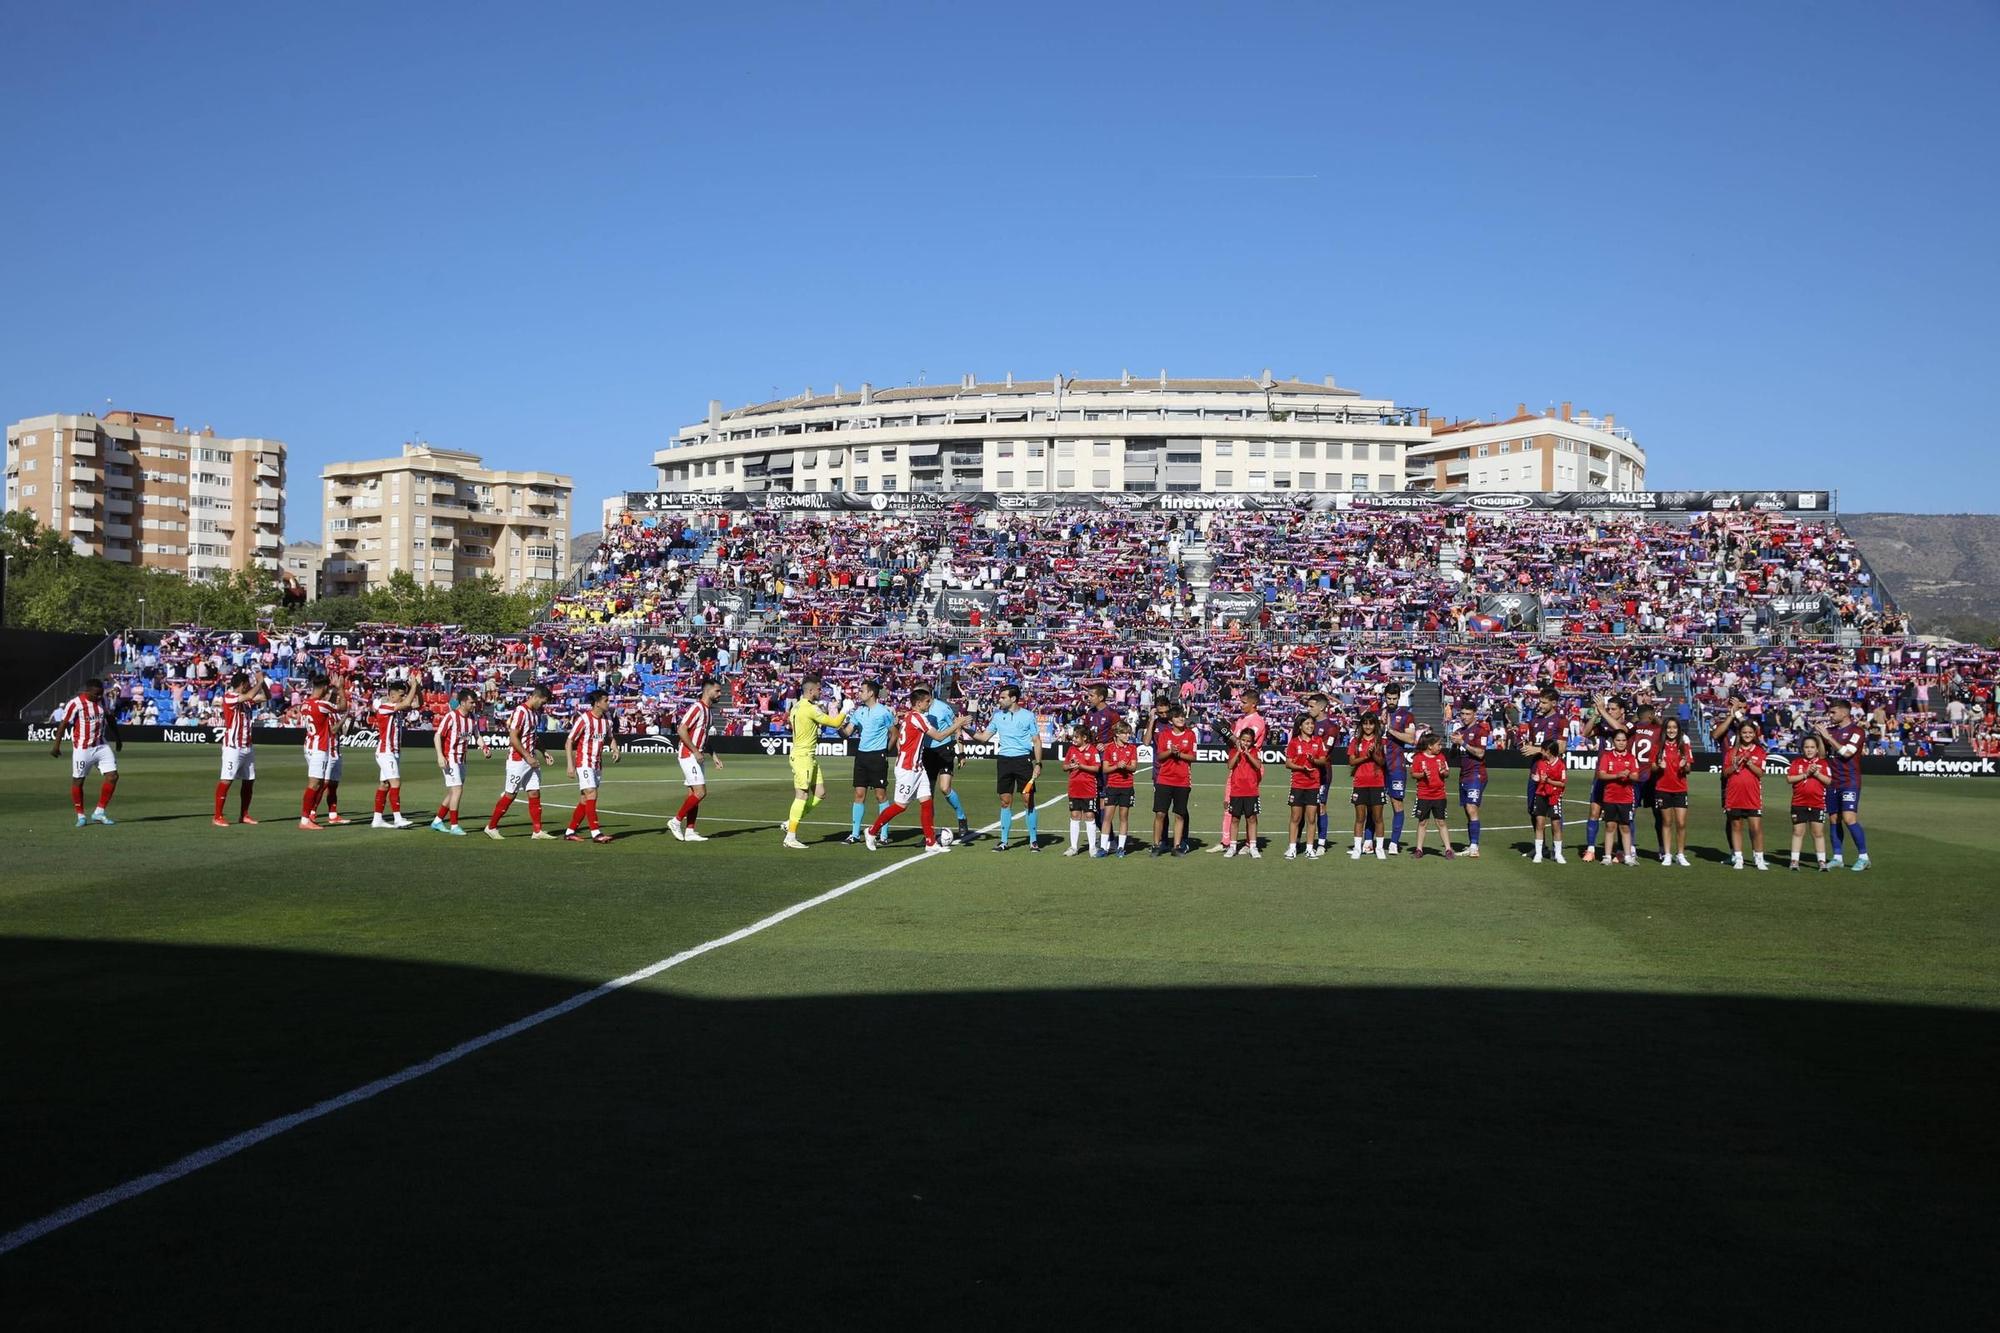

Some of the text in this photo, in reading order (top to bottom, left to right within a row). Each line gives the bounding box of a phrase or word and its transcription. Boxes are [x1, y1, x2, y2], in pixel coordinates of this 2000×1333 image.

[661, 494, 723, 505] INVERCUR
[888, 494, 944, 503] ALIPACK
[1160, 494, 1246, 509] finetwork
[1382, 498, 1411, 506] BOXES
[1609, 493, 1656, 503] PALLEX
[1792, 601, 1820, 609] IMED
[163, 729, 206, 742] Nature
[75, 761, 86, 770] 19
[1897, 756, 1996, 773] finetwork
[583, 770, 589, 779] 6
[692, 766, 698, 776] 4
[510, 775, 521, 785] 22
[899, 784, 912, 795] 23
